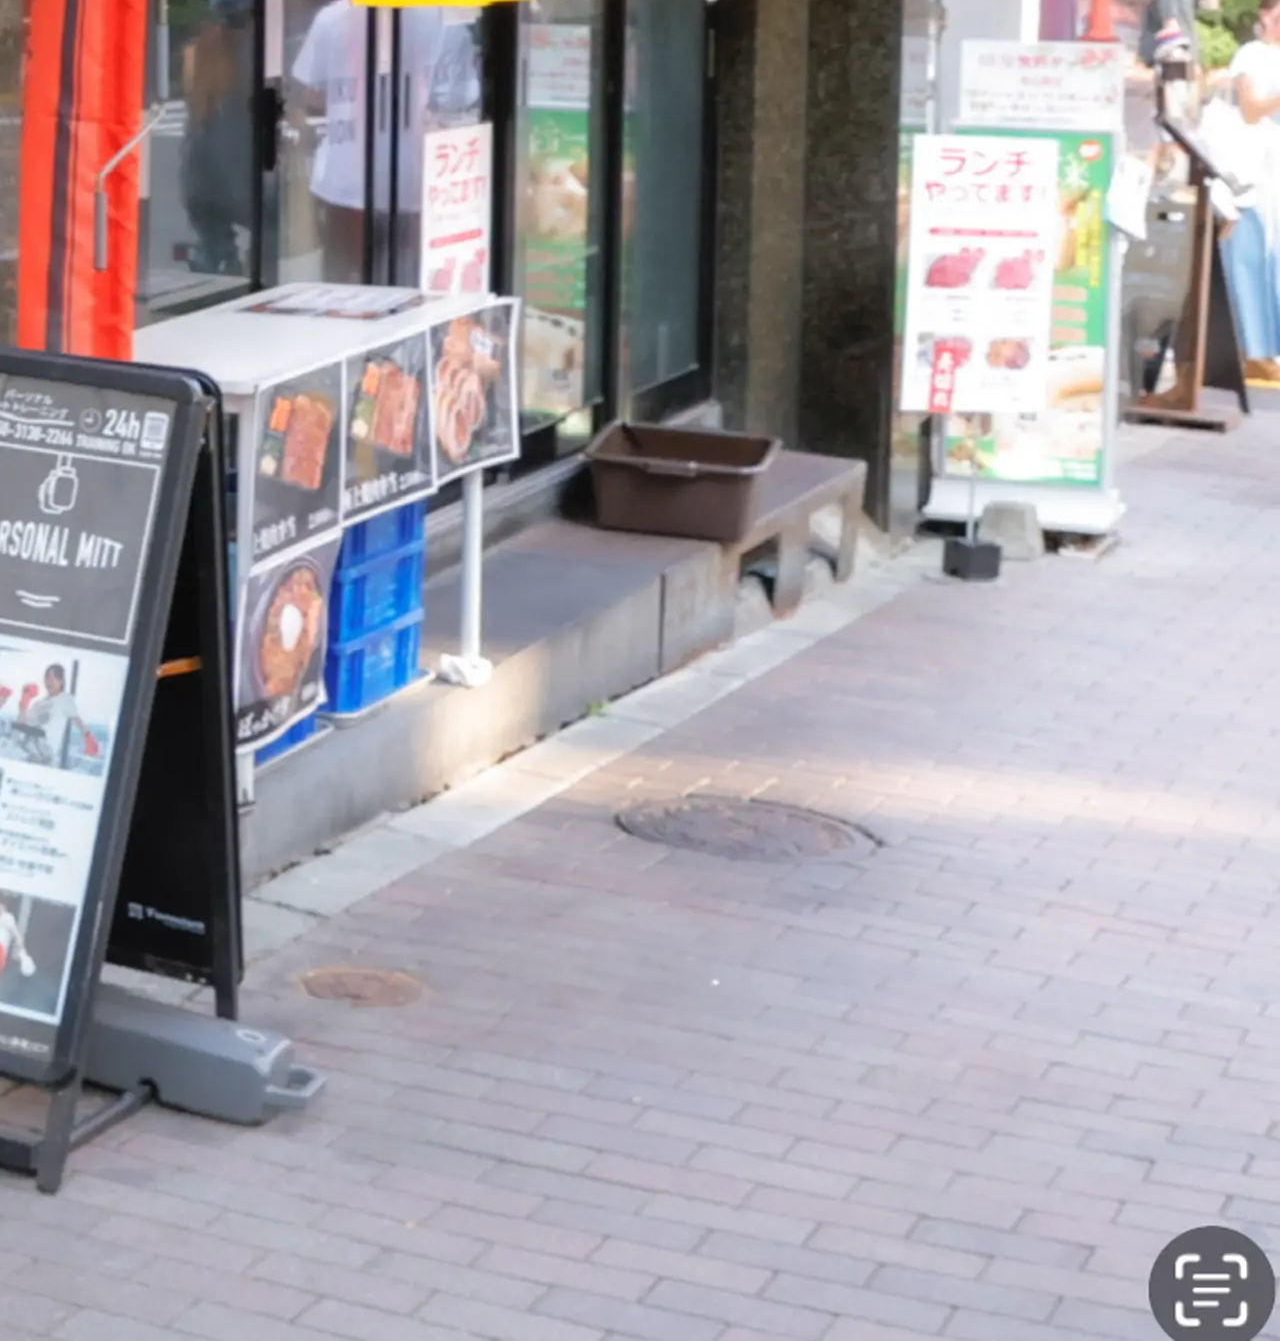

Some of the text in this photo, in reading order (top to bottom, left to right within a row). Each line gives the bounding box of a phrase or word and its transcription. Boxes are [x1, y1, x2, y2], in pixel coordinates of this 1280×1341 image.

[939, 147, 1033, 177] ランチ
[101, 408, 141, 440] 24h
[74, 531, 125, 568] MITT
